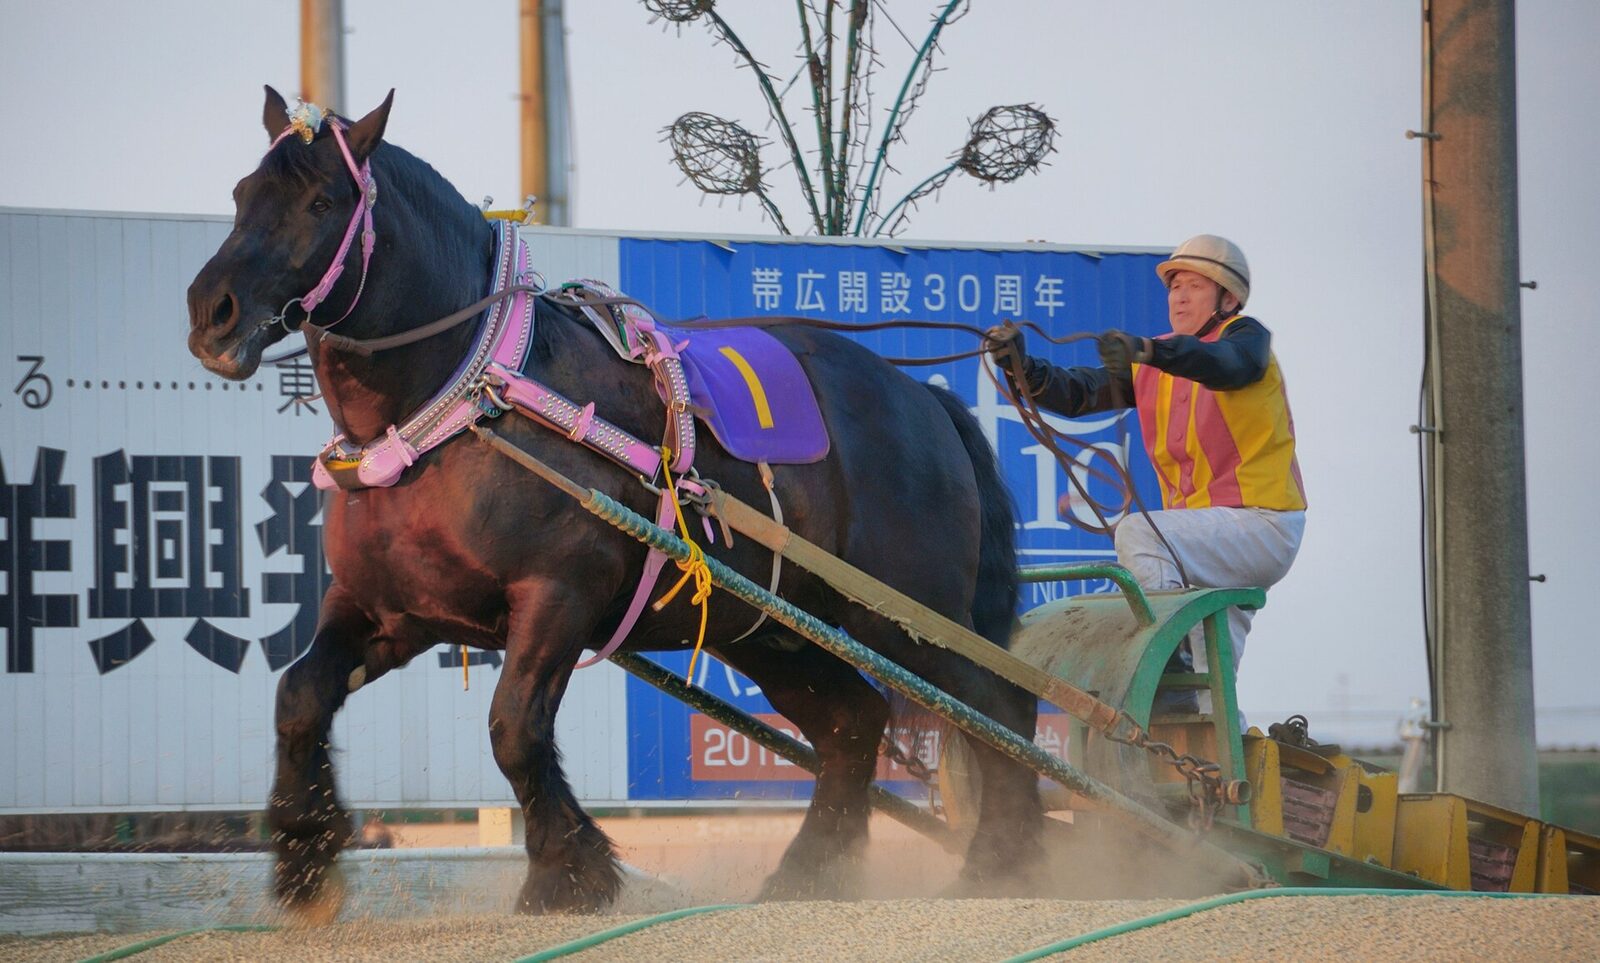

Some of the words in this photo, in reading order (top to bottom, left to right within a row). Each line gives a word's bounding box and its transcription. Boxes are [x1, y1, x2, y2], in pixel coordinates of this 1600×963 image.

[752, 267, 1065, 317] 帯広開設30周年
[718, 346, 774, 428] 1
